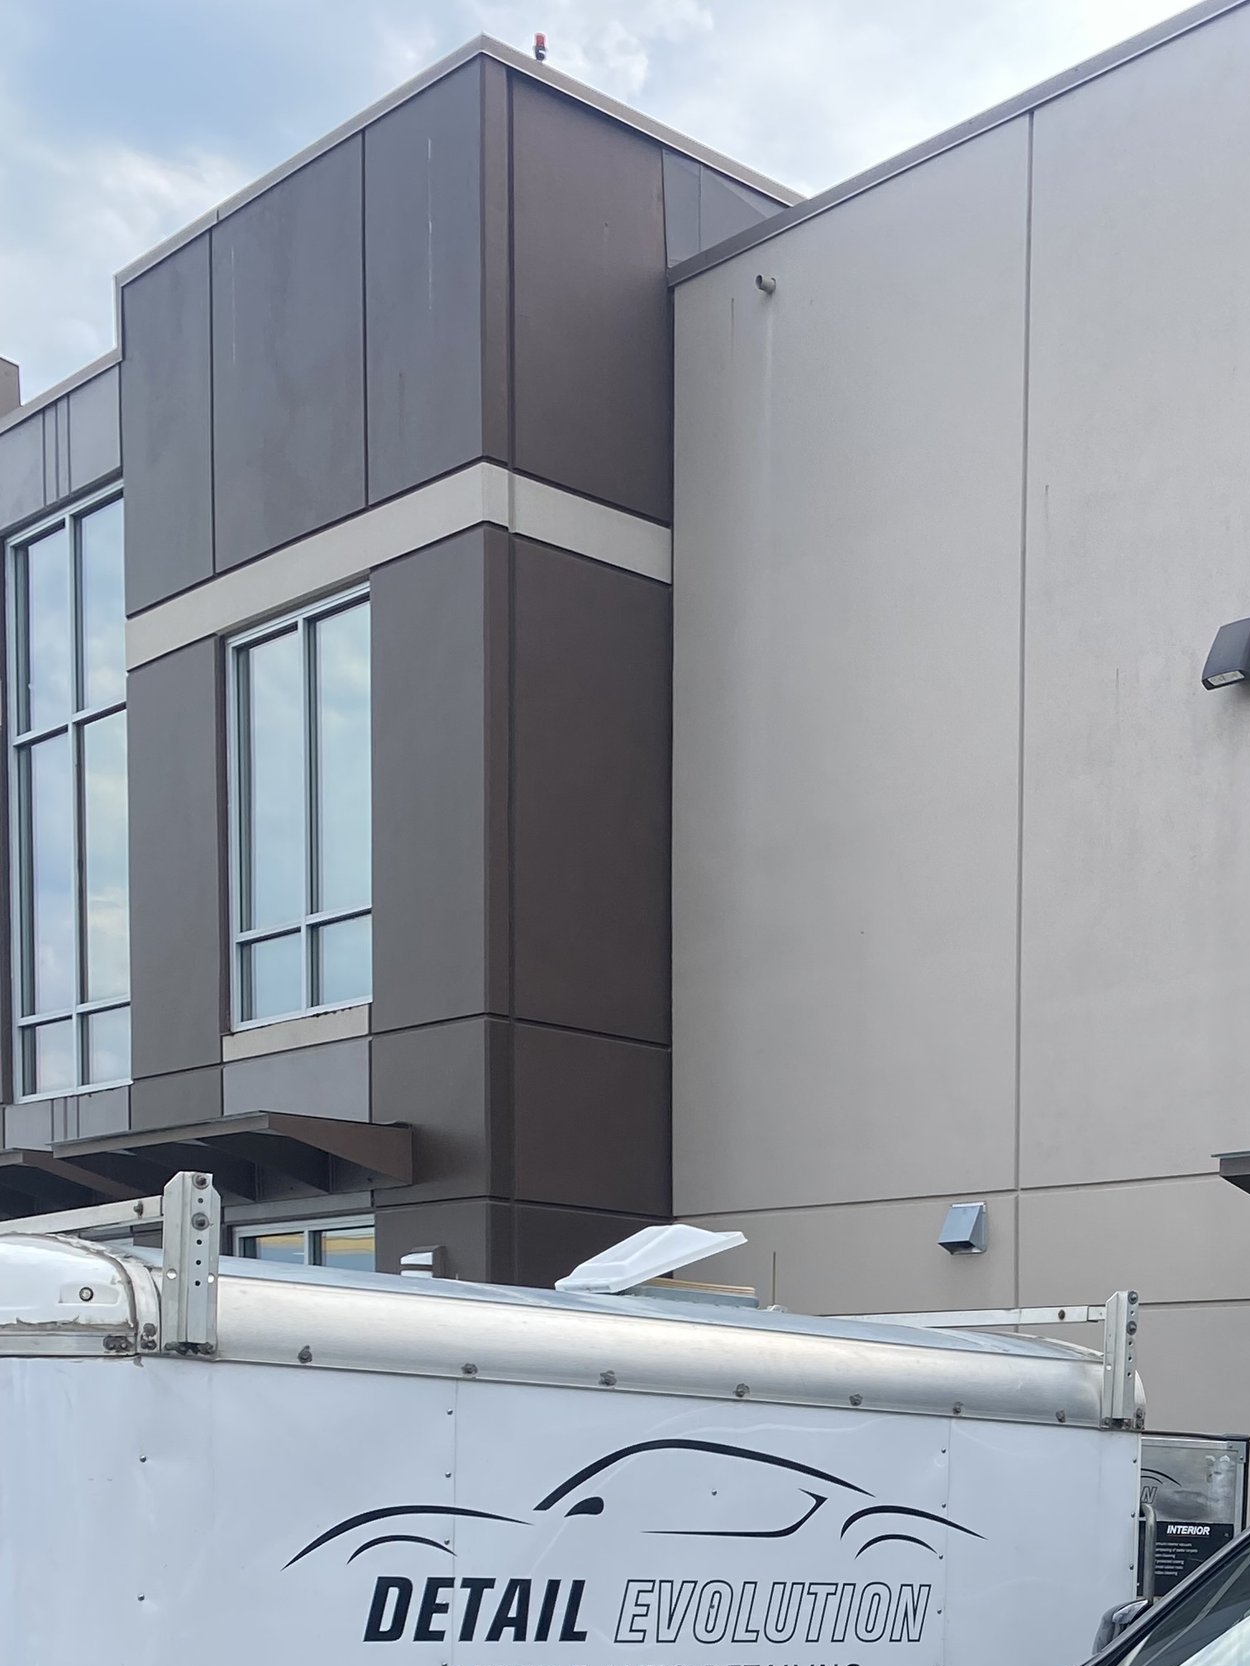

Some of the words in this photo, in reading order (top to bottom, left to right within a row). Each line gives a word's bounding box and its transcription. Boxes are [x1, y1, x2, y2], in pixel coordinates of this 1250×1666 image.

[1166, 1525, 1211, 1536] INTERIOR
[363, 1576, 588, 1643] DETAIL
[613, 1578, 932, 1644] EVOLUTION
